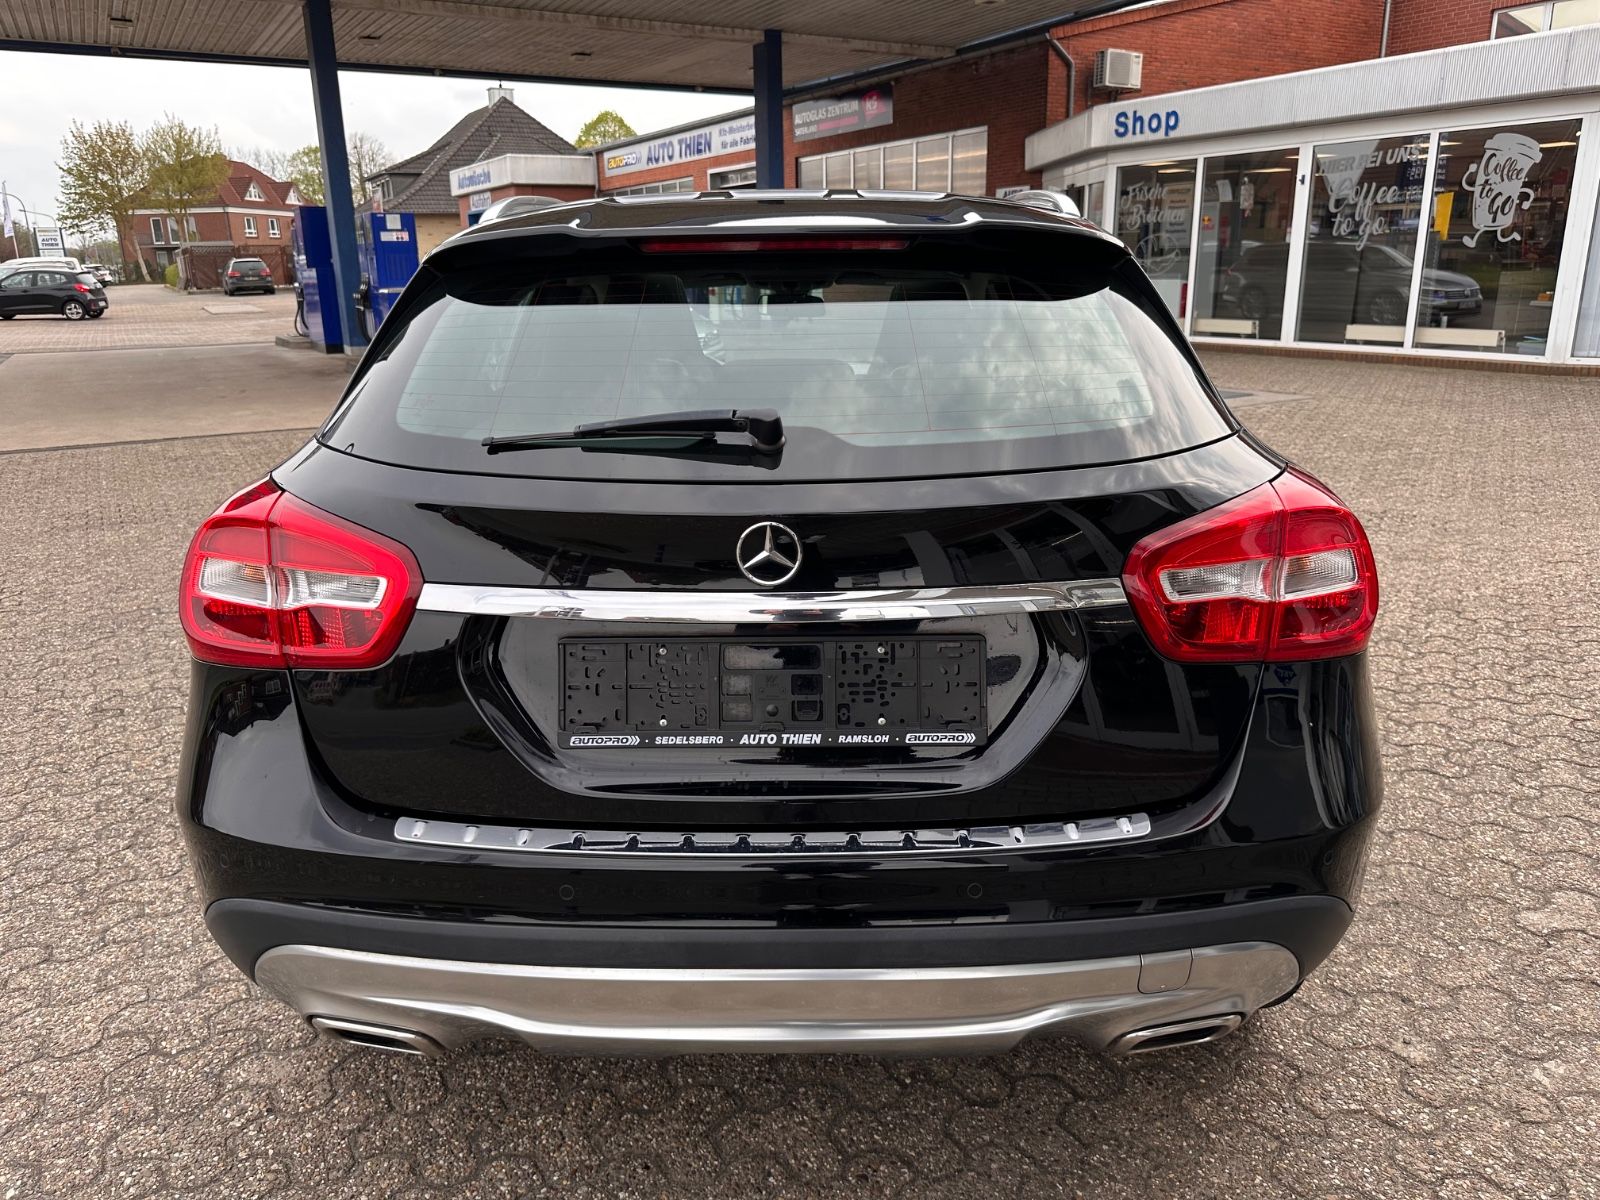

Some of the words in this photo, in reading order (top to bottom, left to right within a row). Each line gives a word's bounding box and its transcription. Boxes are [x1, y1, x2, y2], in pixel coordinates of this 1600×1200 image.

[794, 107, 827, 125] AUTOGLAS
[827, 100, 859, 118] ZENTRUM
[1114, 110, 1179, 138] Shop
[646, 140, 675, 166] AUTO
[678, 131, 712, 159] THIEN
[1386, 144, 1421, 165] UNS
[1482, 152, 1525, 183] Coffee
[1329, 178, 1399, 221] Coffee
[1477, 178, 1495, 200] to
[1331, 211, 1354, 236] to
[1358, 216, 1385, 252] go
[655, 736, 724, 745] SEDELSBERG
[740, 734, 777, 745] AUTO
[781, 734, 822, 745] THIEN
[838, 734, 890, 744] RAMSLOH
